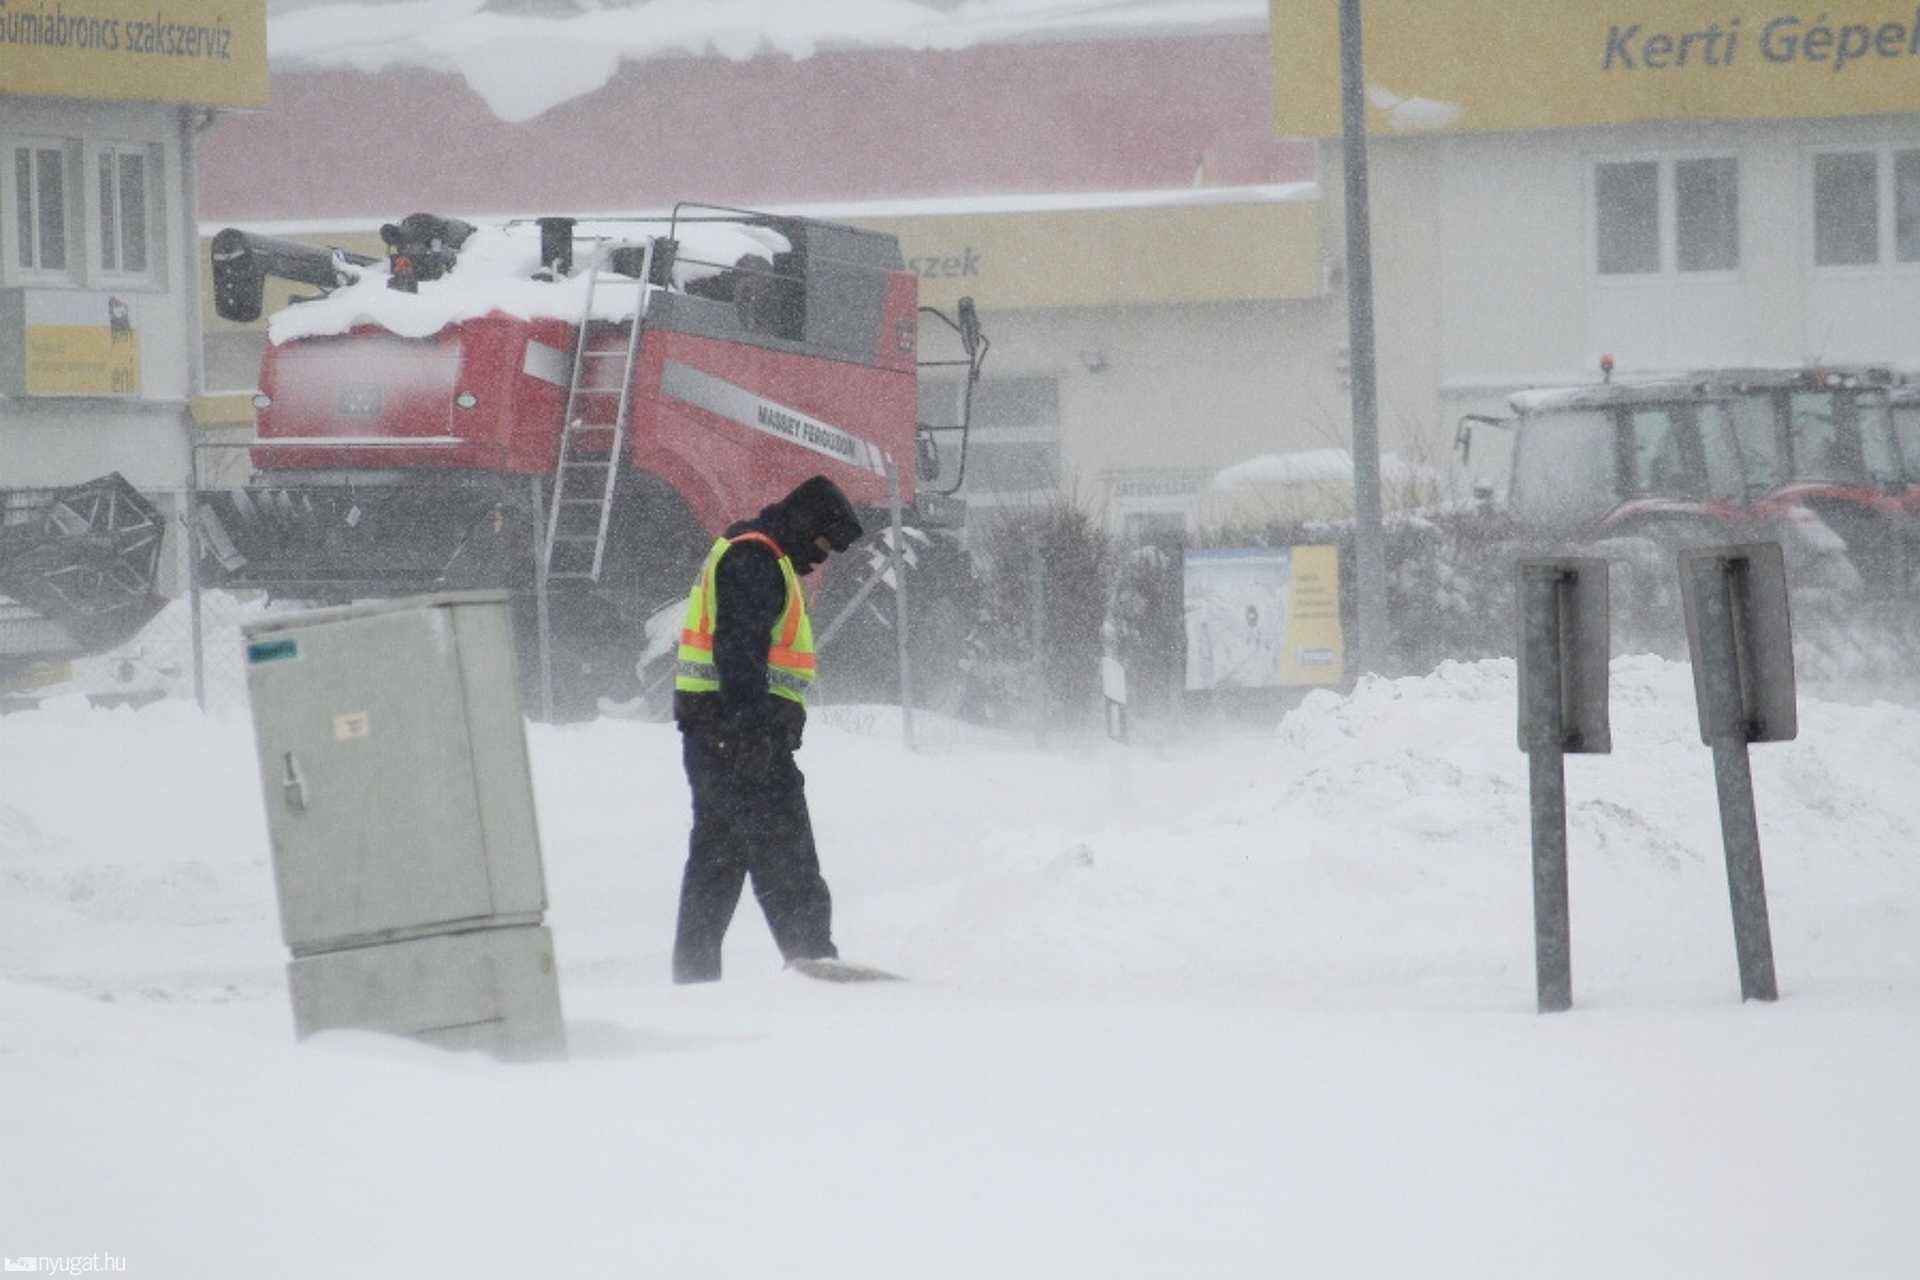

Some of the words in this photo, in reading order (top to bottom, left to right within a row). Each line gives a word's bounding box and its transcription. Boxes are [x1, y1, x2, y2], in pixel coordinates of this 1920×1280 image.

[126, 11, 231, 59] szakszerviz
[1603, 17, 1741, 70] Kerti
[758, 405, 800, 438] MASSEY
